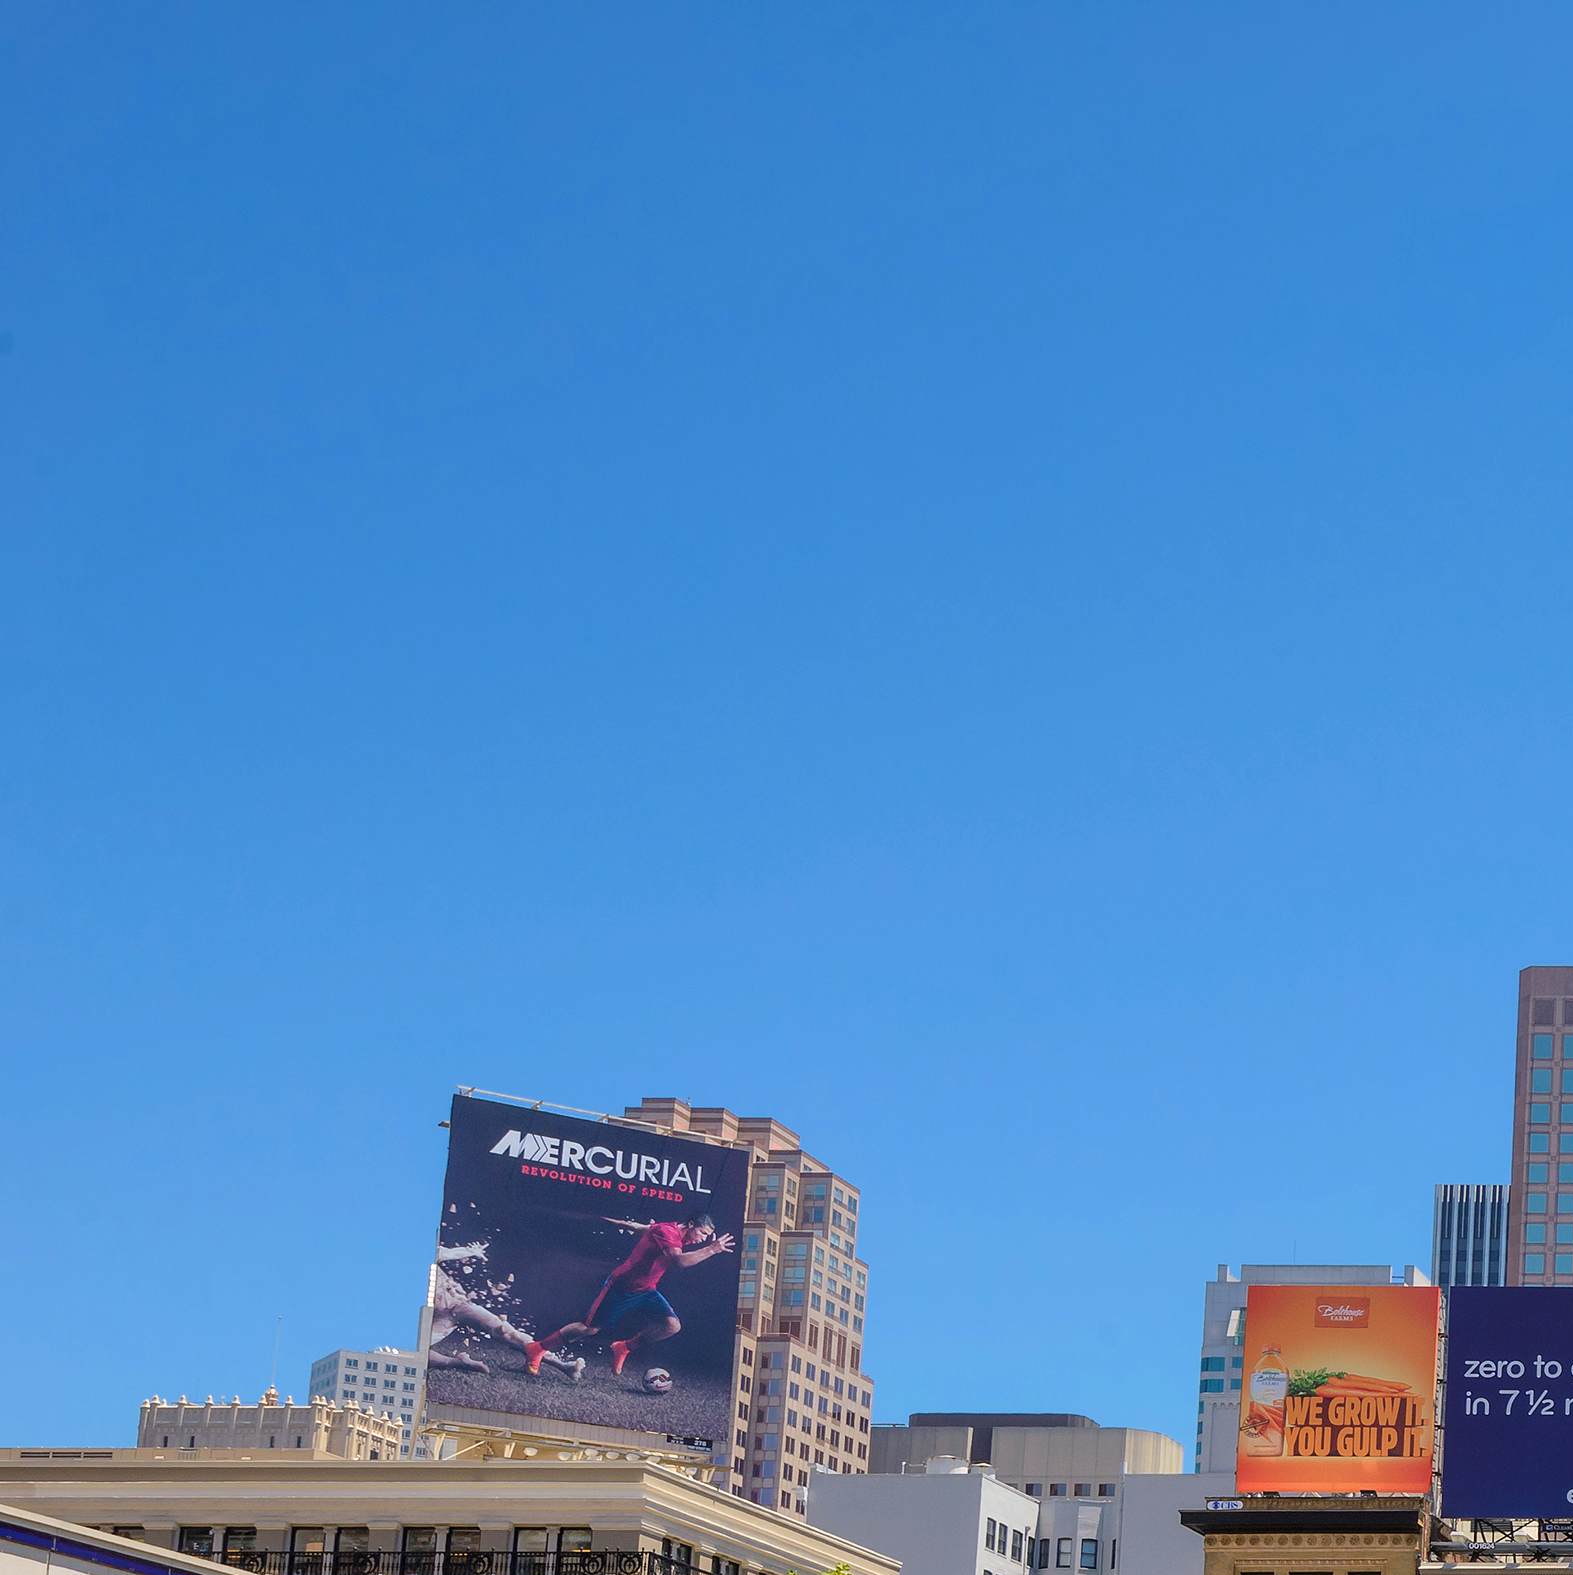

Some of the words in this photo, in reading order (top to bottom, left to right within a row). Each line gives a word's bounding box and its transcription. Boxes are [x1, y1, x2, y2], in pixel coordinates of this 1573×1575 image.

[488, 1129, 712, 1194] MERCURIAL
[521, 1165, 612, 1189] REVOLUTION
[618, 1183, 636, 1194] OF
[641, 1187, 684, 1202] SPEED
[1463, 1360, 1525, 1379] zero
[1533, 1354, 1563, 1379] to
[1285, 1396, 1324, 1426] WE
[1328, 1396, 1401, 1426] GROW
[1465, 1391, 1490, 1416] in
[1284, 1426, 1332, 1457] YOU
[1336, 1426, 1398, 1457] GULP
